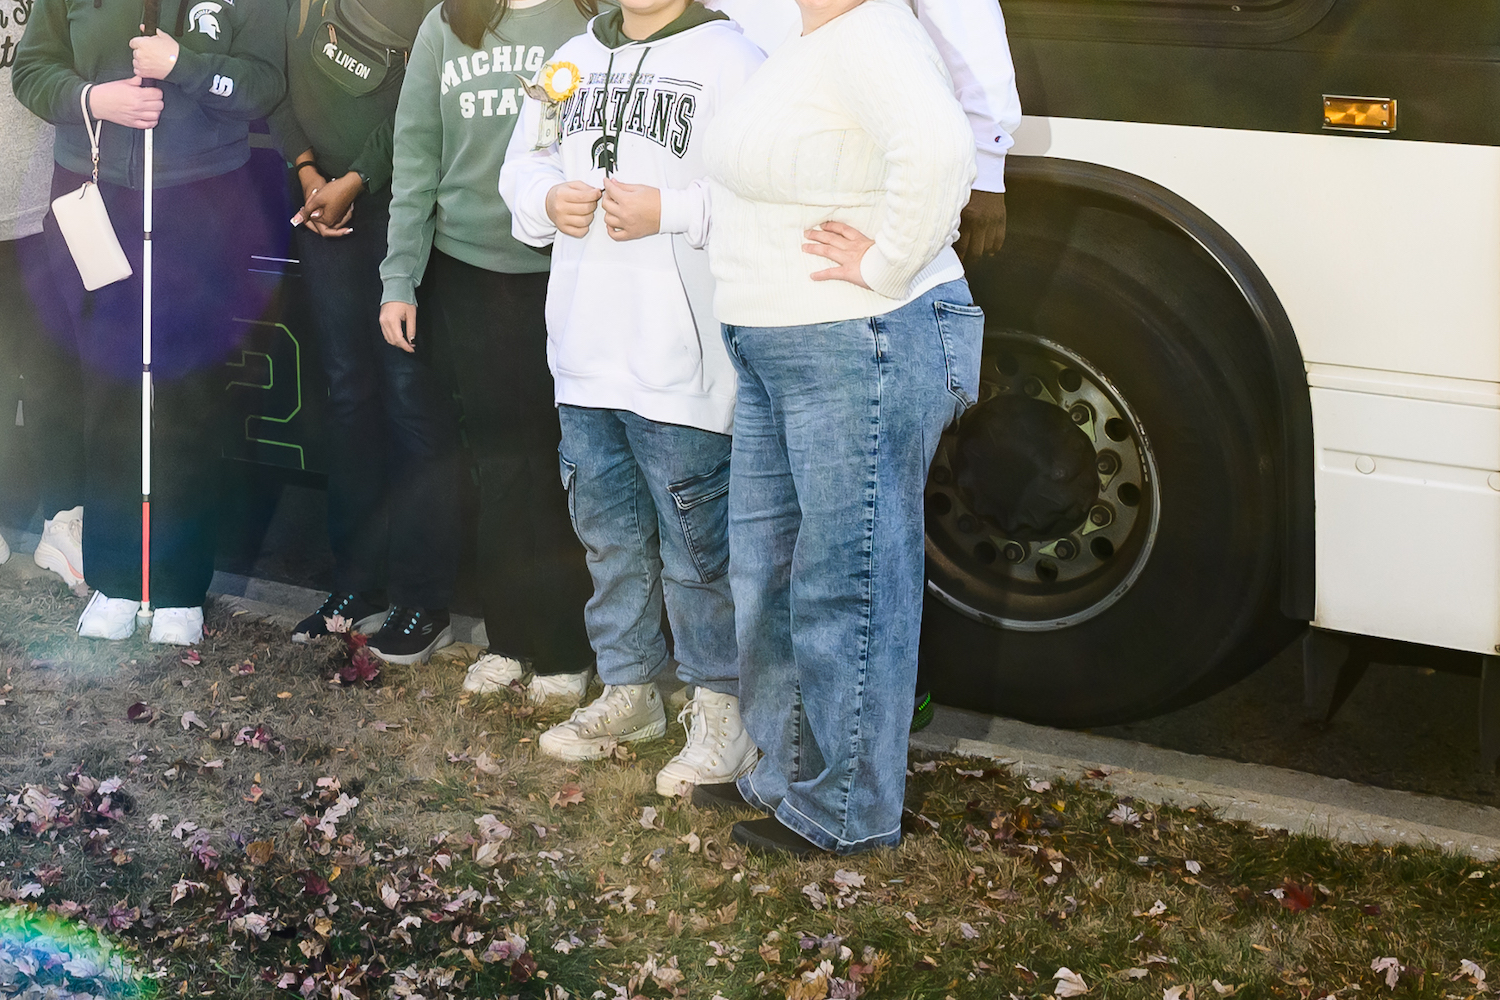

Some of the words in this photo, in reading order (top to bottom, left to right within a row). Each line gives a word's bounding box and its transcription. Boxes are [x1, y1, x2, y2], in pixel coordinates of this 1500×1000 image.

[335, 50, 357, 72] LIVE
[355, 63, 371, 79] ON
[441, 45, 545, 95] MICHIG
